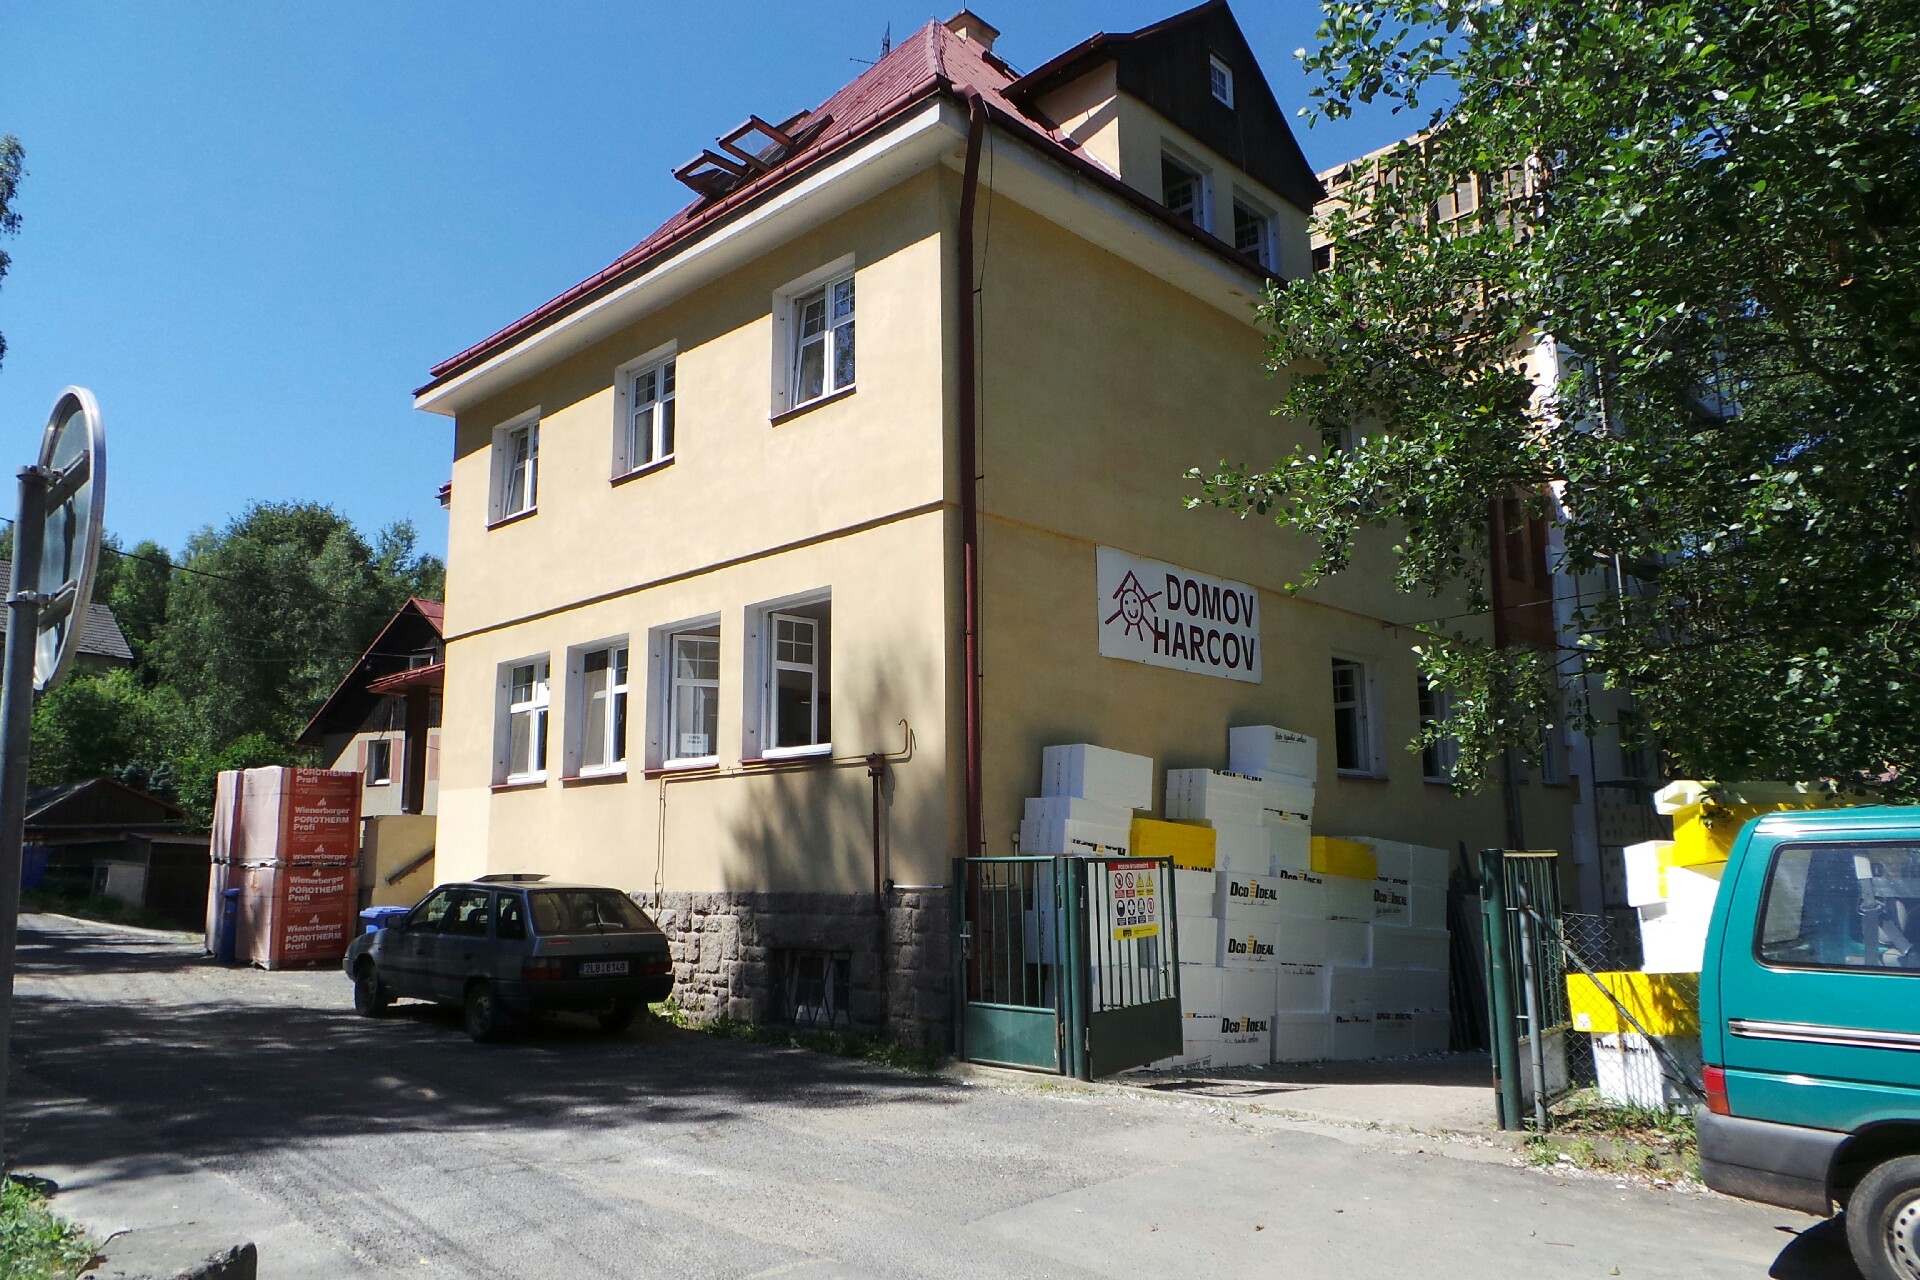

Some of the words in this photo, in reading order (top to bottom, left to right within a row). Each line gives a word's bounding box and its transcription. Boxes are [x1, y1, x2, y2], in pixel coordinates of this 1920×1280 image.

[1166, 573, 1254, 628] DOMOV
[1153, 616, 1255, 671] HARCOV
[296, 775, 318, 783] Profi
[294, 806, 350, 815] Wienerberger
[294, 816, 349, 824] POROTHERM
[293, 823, 315, 831] Profi
[290, 876, 344, 885] Wienerberger
[288, 884, 344, 894] POROTHERM
[1255, 884, 1278, 900] IDEAL
[288, 893, 311, 901] Profi
[287, 923, 342, 933] Wienerberger
[285, 932, 342, 943] POROTHERM
[284, 942, 307, 951] Profi
[1252, 940, 1275, 955] IDEAL
[1246, 1017, 1268, 1033] IDEAL
